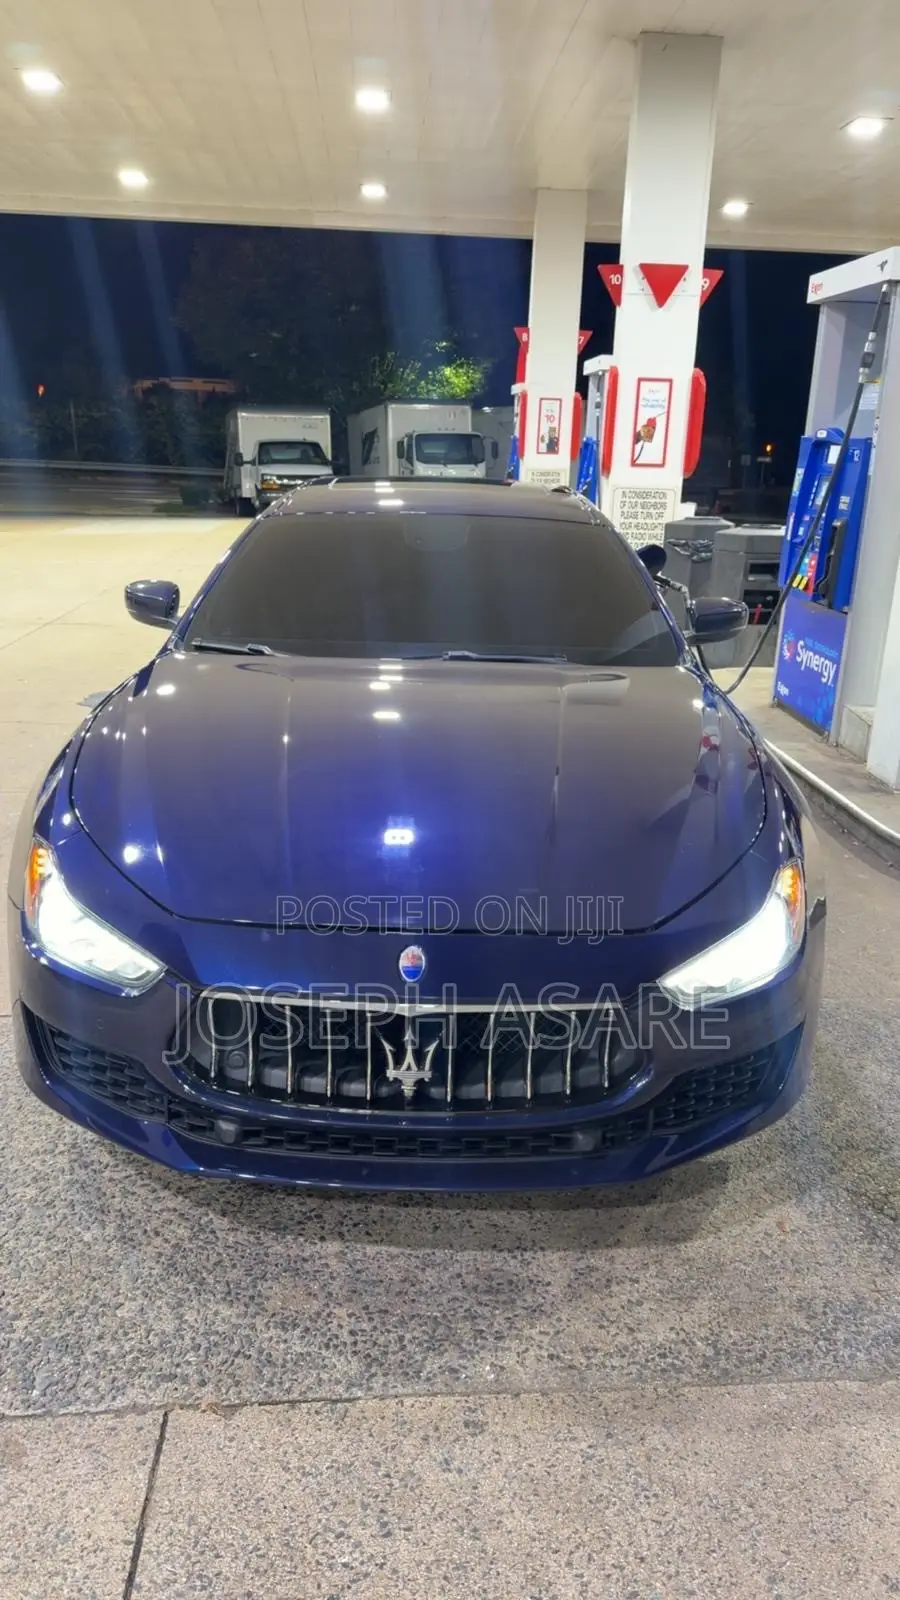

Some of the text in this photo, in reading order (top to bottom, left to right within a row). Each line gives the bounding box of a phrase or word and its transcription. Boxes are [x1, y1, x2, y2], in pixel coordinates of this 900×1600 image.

[609, 273, 622, 285] 10
[701, 278, 710, 291] 9
[522, 332, 529, 342] 8
[796, 640, 837, 687] Synergy
